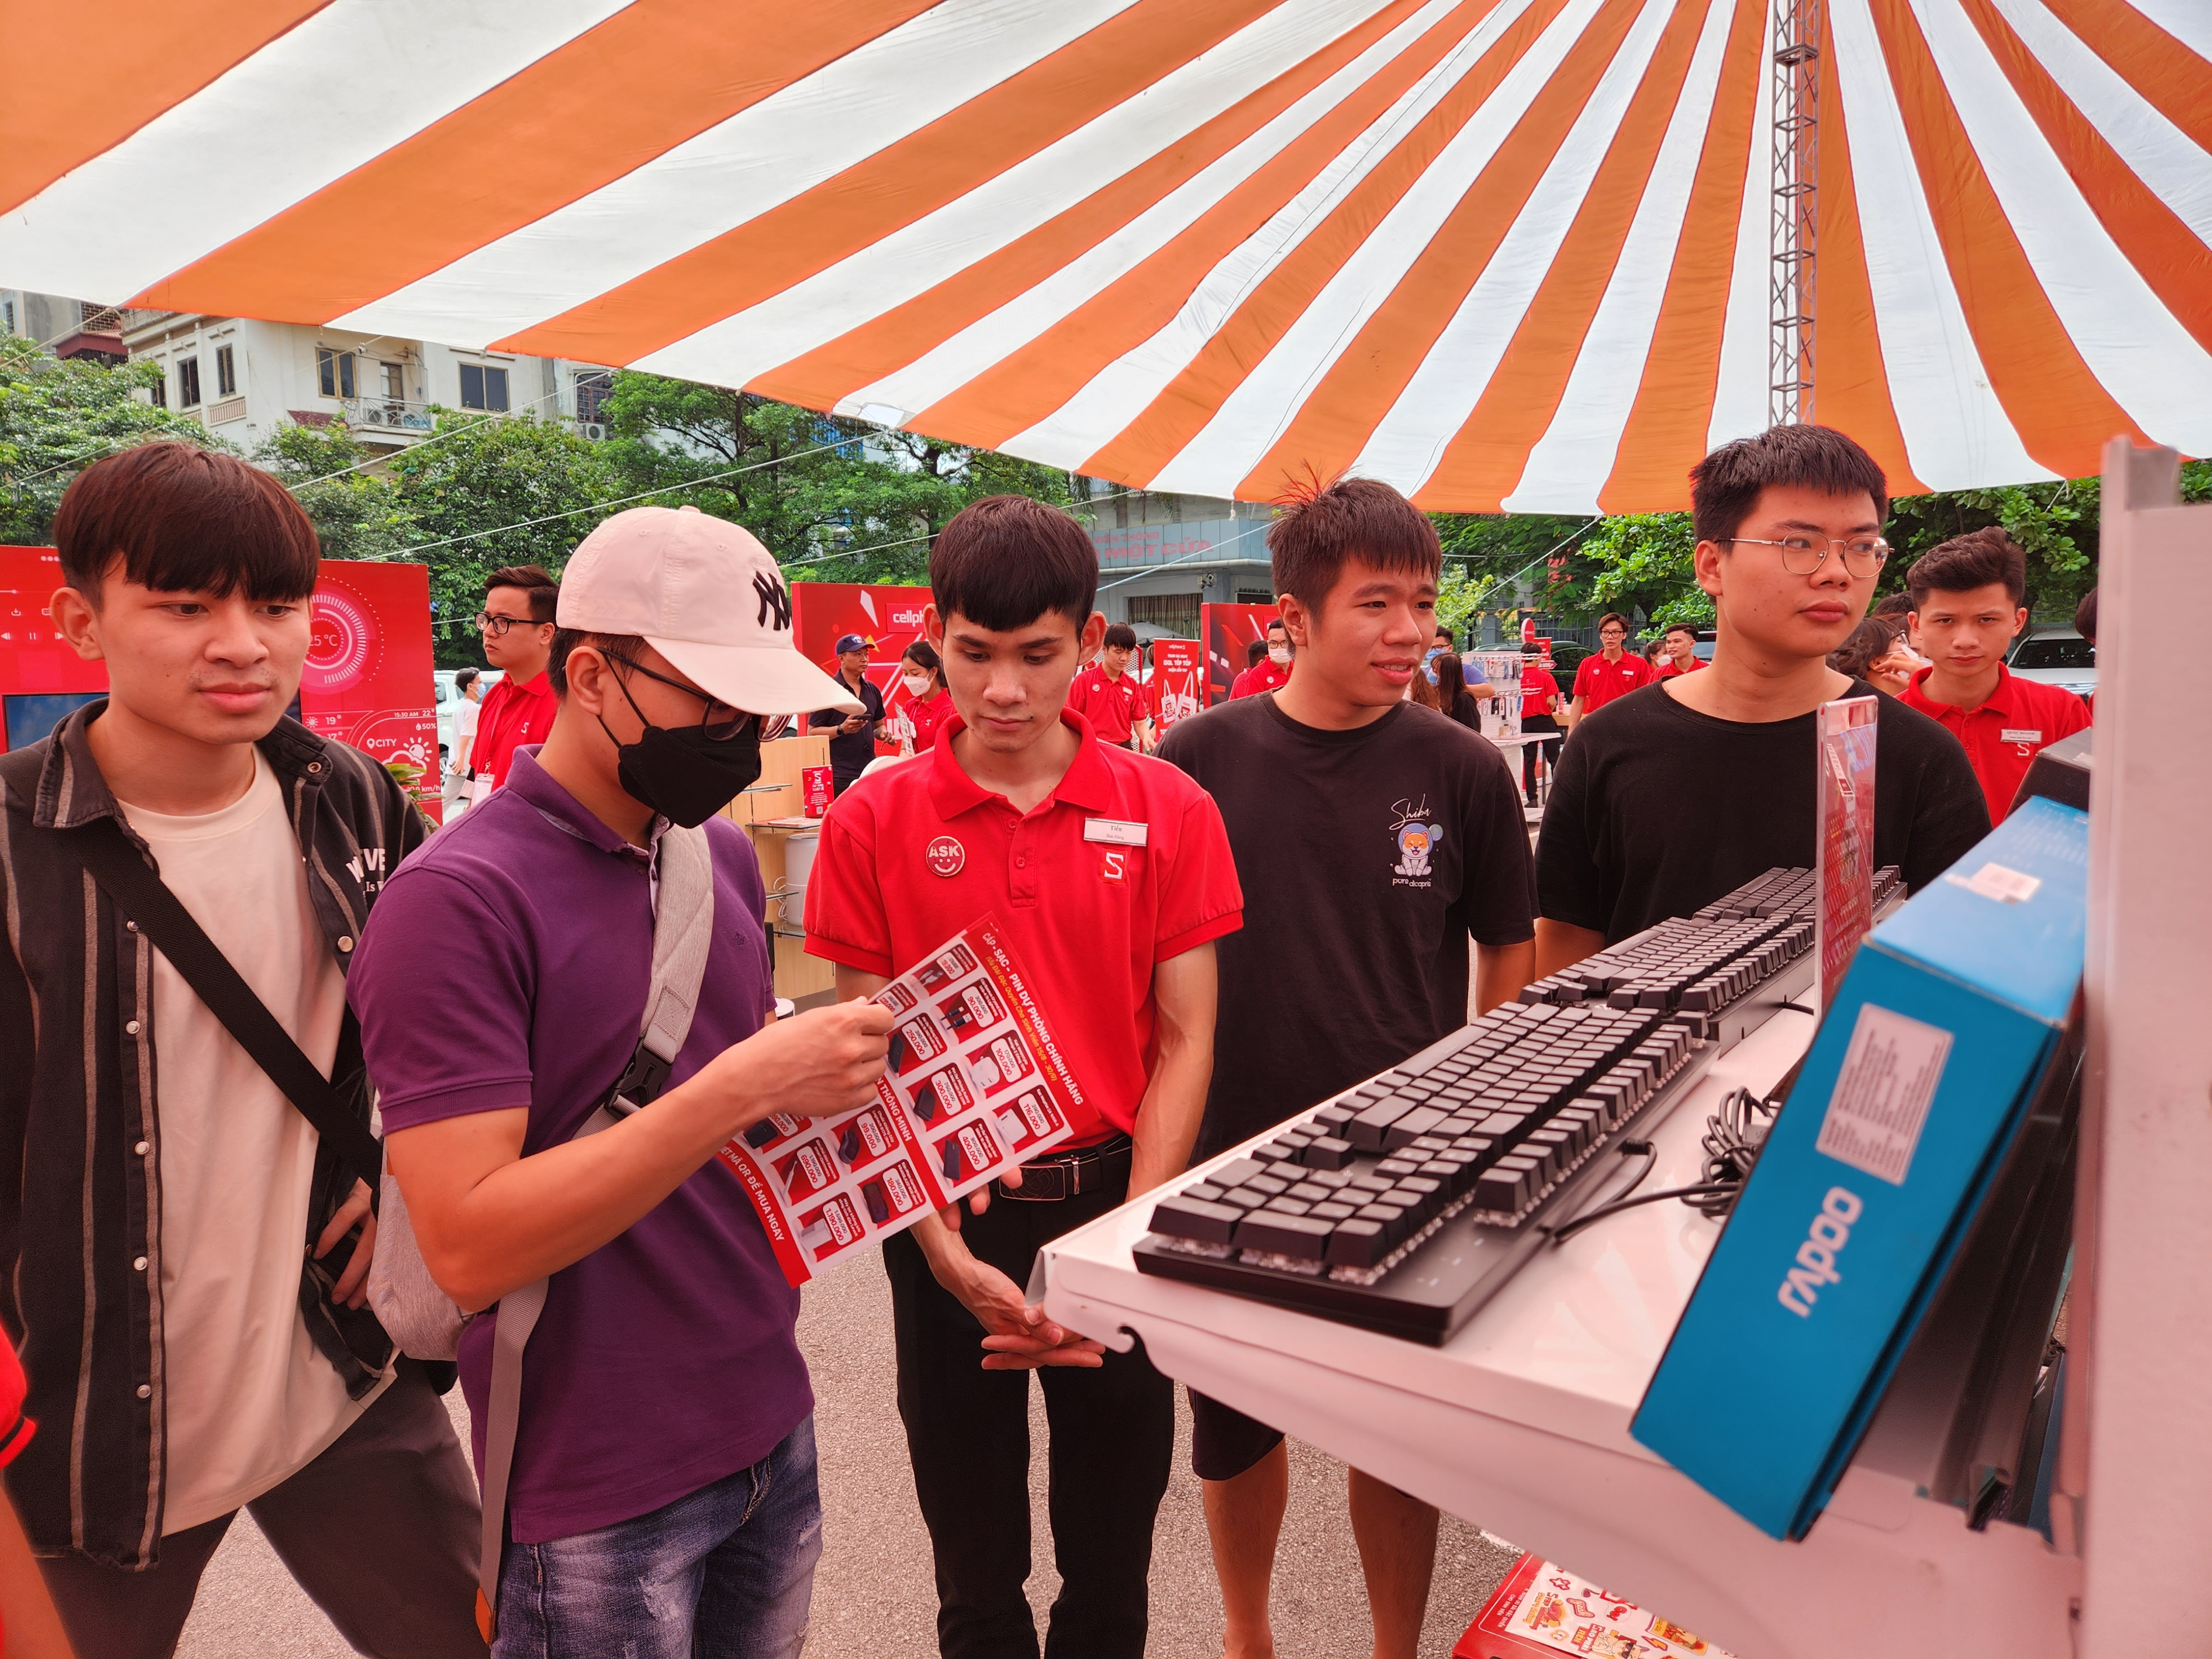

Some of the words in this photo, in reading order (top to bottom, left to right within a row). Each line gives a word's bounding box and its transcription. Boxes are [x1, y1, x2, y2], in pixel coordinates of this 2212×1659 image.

[375, 738, 397, 747] CITY
[928, 845, 960, 858] ASK
[967, 996, 984, 1020] 90.000
[992, 947, 1010, 969] SẠC
[1008, 972, 1024, 992] PIN
[1016, 989, 1034, 1010] DỰ
[1025, 1005, 1053, 1044] PHÒNG
[1044, 1041, 1070, 1076] CHÍNH
[1061, 1073, 1086, 1105] HÃNG
[905, 1028, 925, 1056] 250.000
[1015, 1005, 1026, 1019] Cho
[1021, 1017, 1034, 1033] Sinh
[1035, 1046, 1047, 1061] 15/8
[1044, 1063, 1058, 1082] 30/9)
[994, 1047, 1013, 1076] 100.000
[933, 1079, 954, 1109] 300.000
[942, 1082, 957, 1102] 750.000
[878, 1082, 902, 1117] THÔNG
[894, 1115, 914, 1141] MINH
[1022, 1103, 1041, 1130] 116.000
[859, 1122, 879, 1149] 99.000
[868, 1123, 882, 1142] 200.000
[727, 1151, 743, 1166] MÃ
[961, 1135, 981, 1165] 400.000
[737, 1161, 752, 1177] QR
[745, 1173, 763, 1191] ĐỂ
[799, 1154, 820, 1183] 690.000
[753, 1189, 774, 1214] MUA
[885, 1177, 905, 1206] 180.000
[763, 1212, 788, 1243] NGAY
[823, 1208, 846, 1241] 1.190.000
[1501, 1599, 1510, 1609] SINH
[1507, 1593, 1515, 1602] CHO
